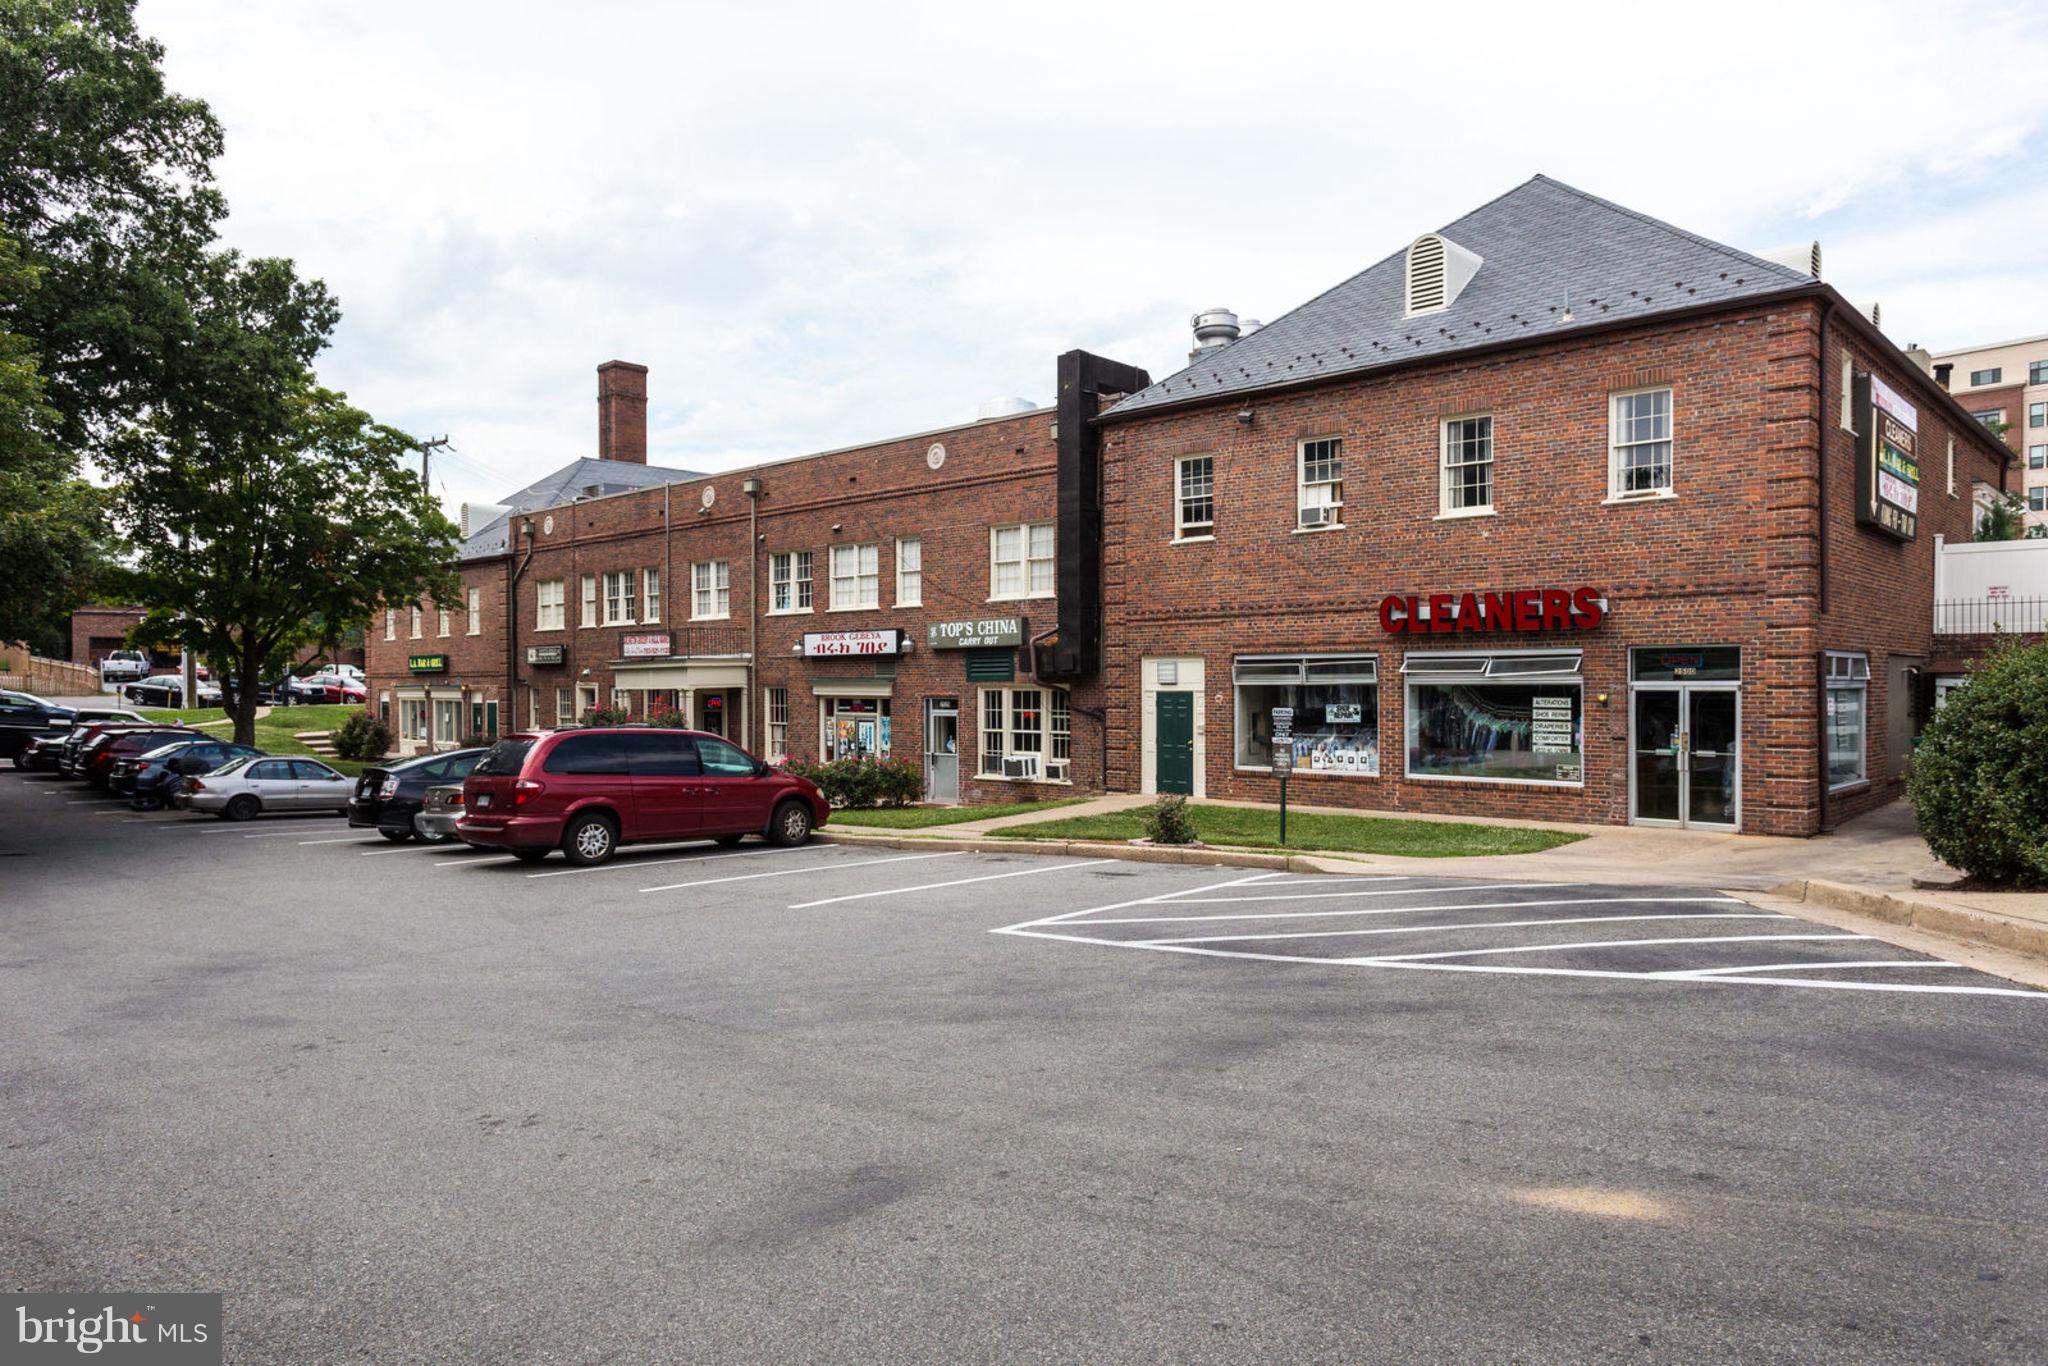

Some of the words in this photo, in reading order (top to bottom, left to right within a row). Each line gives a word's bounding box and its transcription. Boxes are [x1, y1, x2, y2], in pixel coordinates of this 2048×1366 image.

[1885, 418, 1912, 452] CLEANERS
[1380, 587, 1602, 633] CLEANERS
[940, 621, 974, 637] TOP'S
[978, 619, 1018, 635] CHINA
[959, 637, 981, 646] CARRY
[984, 636, 999, 645] OUT
